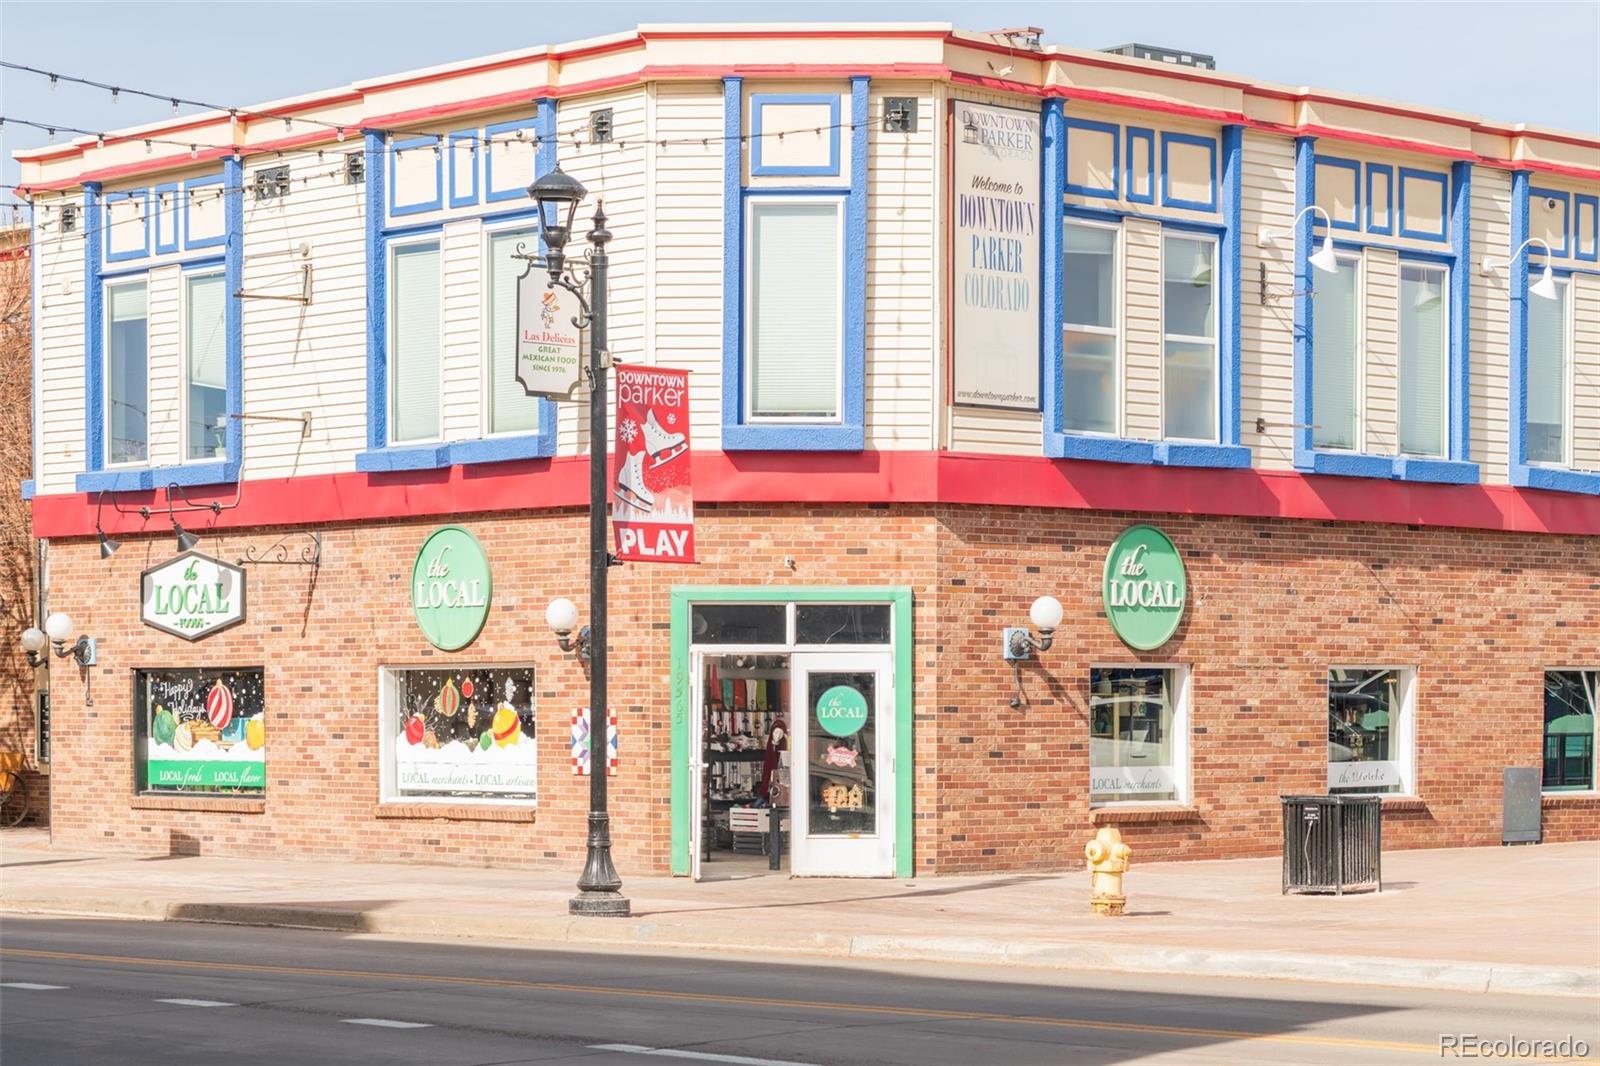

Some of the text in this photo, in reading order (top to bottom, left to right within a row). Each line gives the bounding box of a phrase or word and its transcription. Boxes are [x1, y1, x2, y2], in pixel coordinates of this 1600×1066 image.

[962, 110, 1033, 132] DOWNTOWN
[981, 128, 1033, 150] PARKER
[971, 175, 1024, 195] Welcome to
[960, 193, 1035, 236] DOWNTOWN
[972, 234, 1023, 273] PARKER
[964, 272, 1030, 312] COLORADO
[524, 330, 576, 344] Las Delicias
[522, 354, 577, 364] MEXICAN FOOD
[538, 346, 561, 354] GREAT
[533, 364, 551, 372] SINCE
[618, 372, 685, 387] DOWNTOWN
[618, 384, 685, 408] parker
[619, 528, 690, 557] PLAY
[183, 559, 200, 581] the
[427, 544, 452, 578] the
[1120, 543, 1148, 576] the
[154, 582, 230, 615] LOCAL
[416, 579, 485, 609] LOCAL
[1109, 579, 1182, 608] LOCAL
[160, 678, 194, 701] Happy
[828, 692, 844, 707] the
[167, 699, 206, 721] Holidays
[821, 707, 864, 719] LOCAL
[159, 770, 183, 781] LOCAL
[214, 771, 239, 783] LOCAL
[401, 772, 430, 784] LOCAL
[475, 774, 504, 786] LOCAL
[1092, 768, 1162, 790] LOCAL merchants
